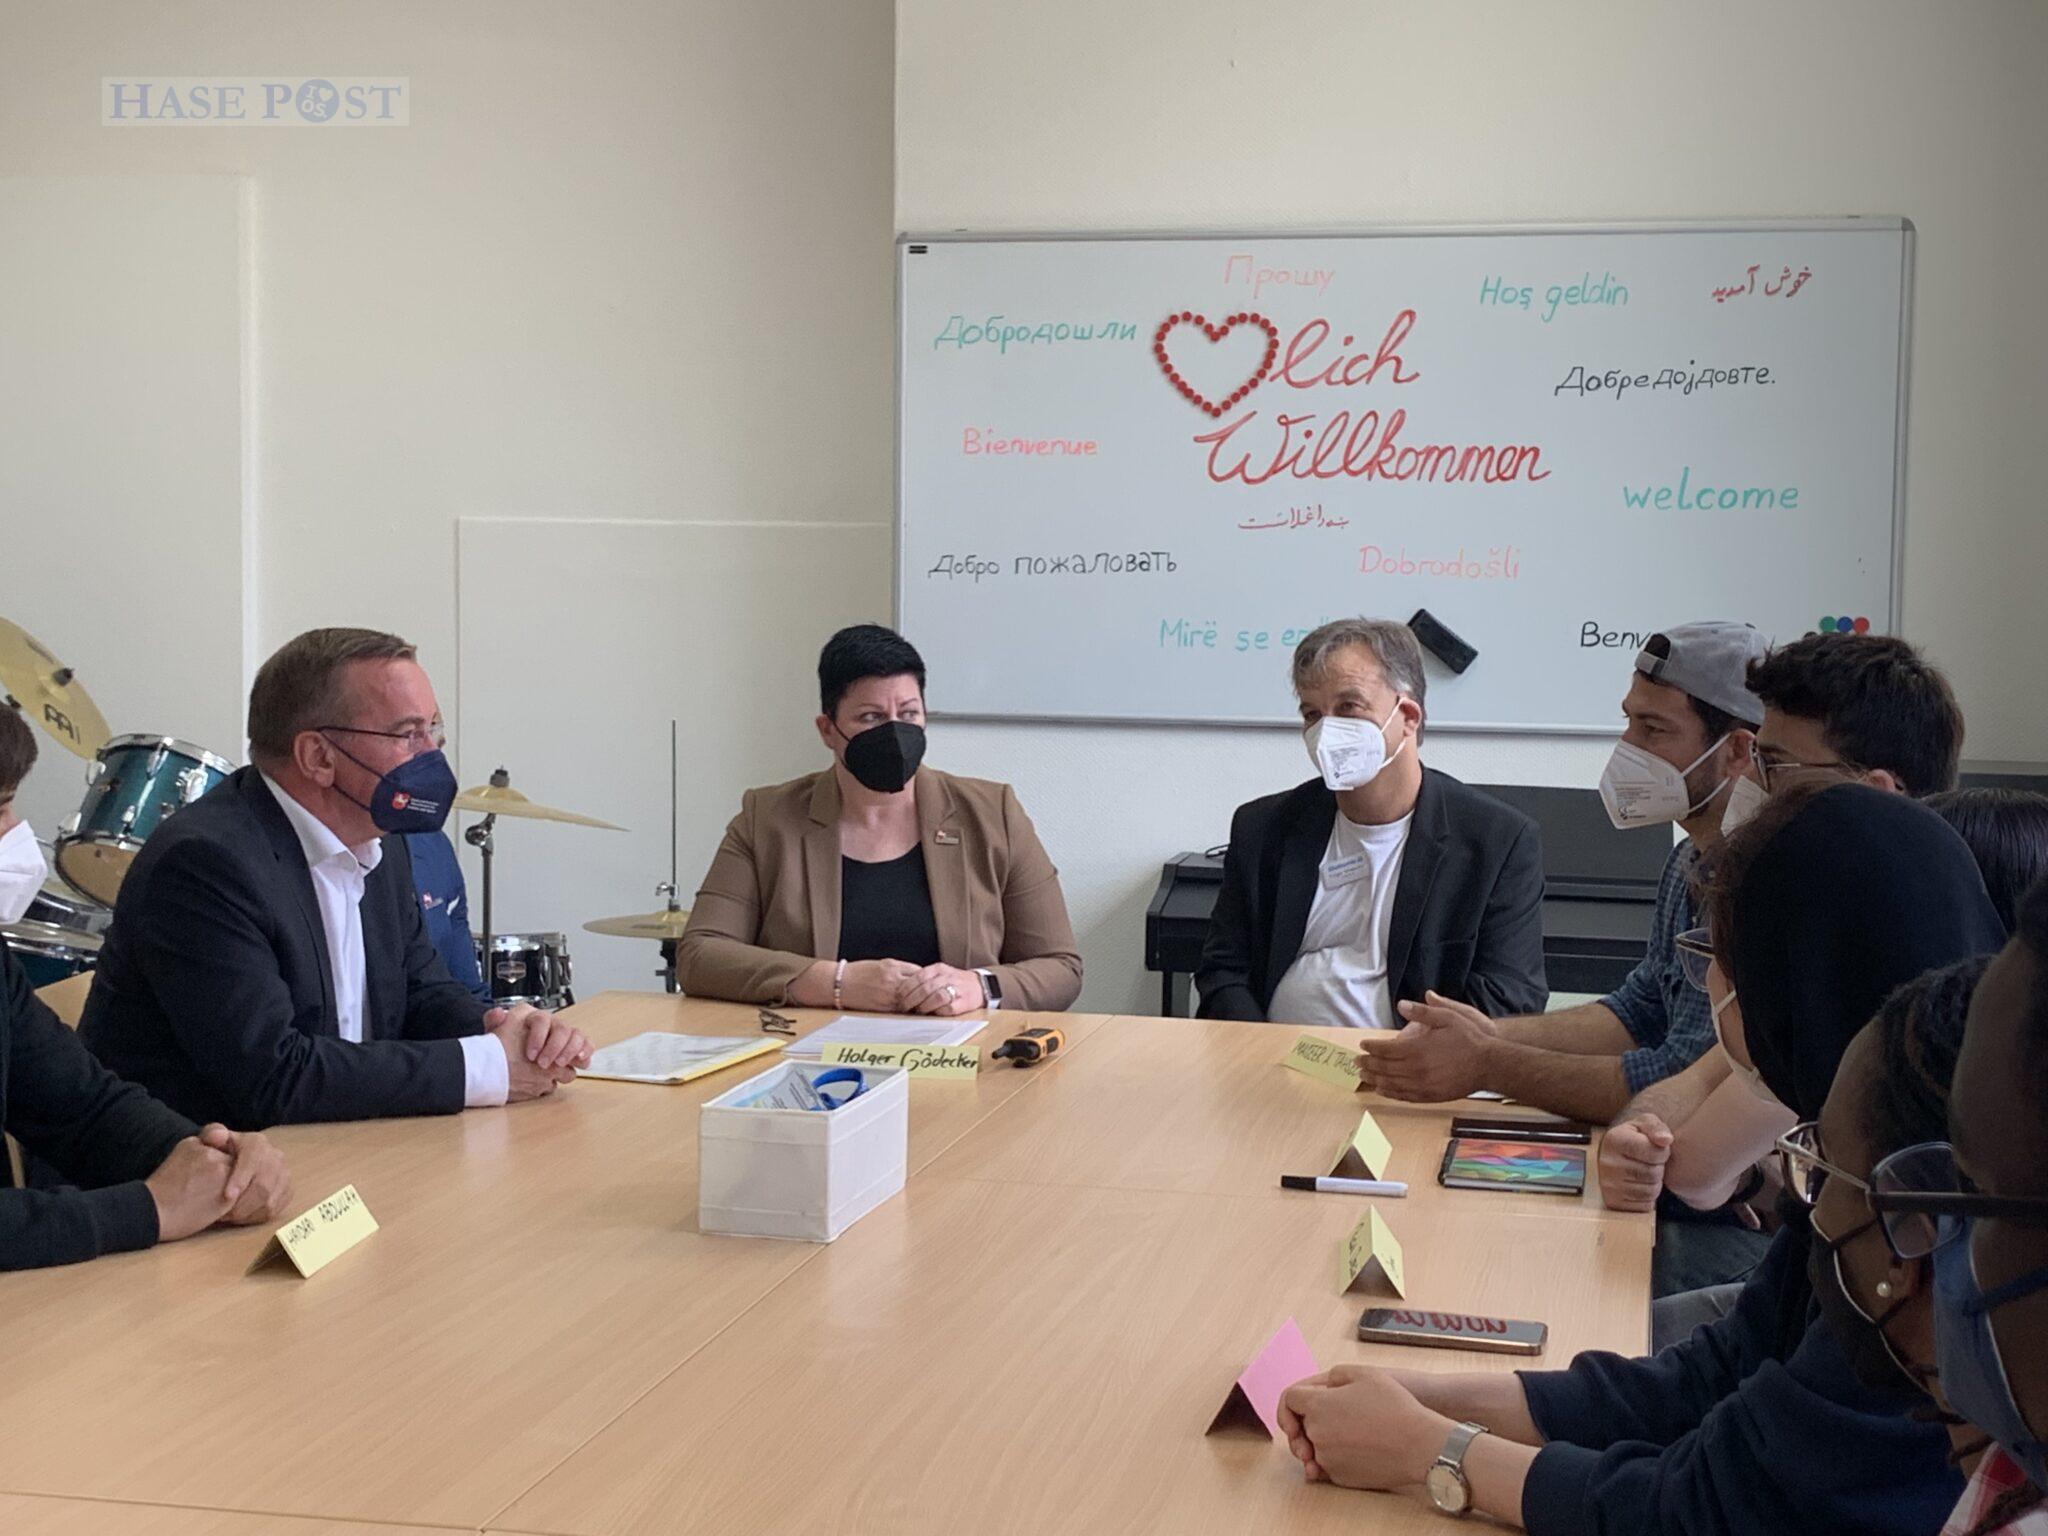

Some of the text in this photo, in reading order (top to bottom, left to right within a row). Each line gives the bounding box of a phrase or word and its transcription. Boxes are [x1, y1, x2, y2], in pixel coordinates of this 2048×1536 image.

[1224, 254, 1335, 299] Прошу
[1479, 271, 1629, 323] Hoş geldin
[933, 315, 1138, 353] Добродошли
[1269, 308, 1420, 388] lich
[962, 427, 1099, 456] Bienvenue
[1193, 409, 1552, 485] Willkommen
[1622, 467, 1799, 511] welcome
[928, 551, 1178, 582] Добро пожаловать
[1359, 546, 1520, 579] Dobrodošli
[1159, 617, 1219, 648] Mirë
[1234, 629, 1269, 652] se
[1580, 620, 1652, 650] Benv
